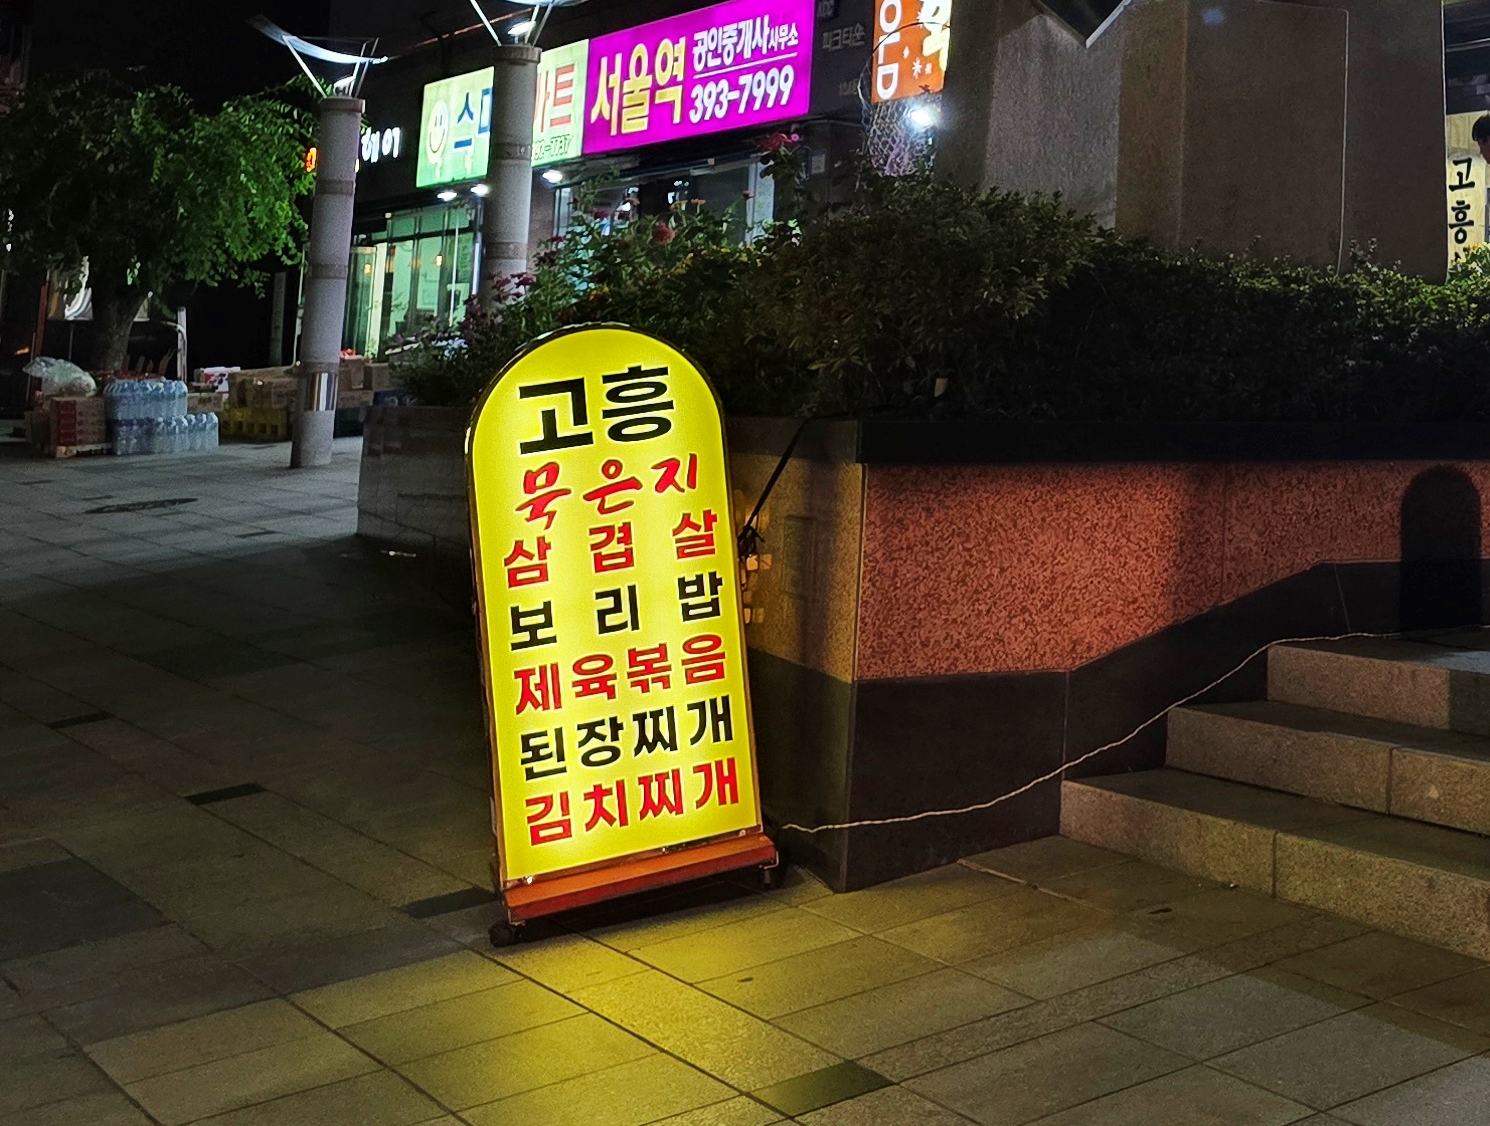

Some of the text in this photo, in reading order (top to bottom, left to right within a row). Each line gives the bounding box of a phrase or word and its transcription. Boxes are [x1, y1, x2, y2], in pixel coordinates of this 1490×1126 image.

[590, 36, 687, 136] 서울역
[688, 64, 795, 124] 393-7999
[517, 364, 676, 455] 고흥
[515, 452, 700, 529] 묵은지
[503, 509, 719, 589] 삼겹살
[509, 571, 724, 652] 보리밥
[513, 633, 727, 716] 제육볶음
[520, 694, 734, 782] 된장찌개
[525, 756, 740, 847] 김치찌개
